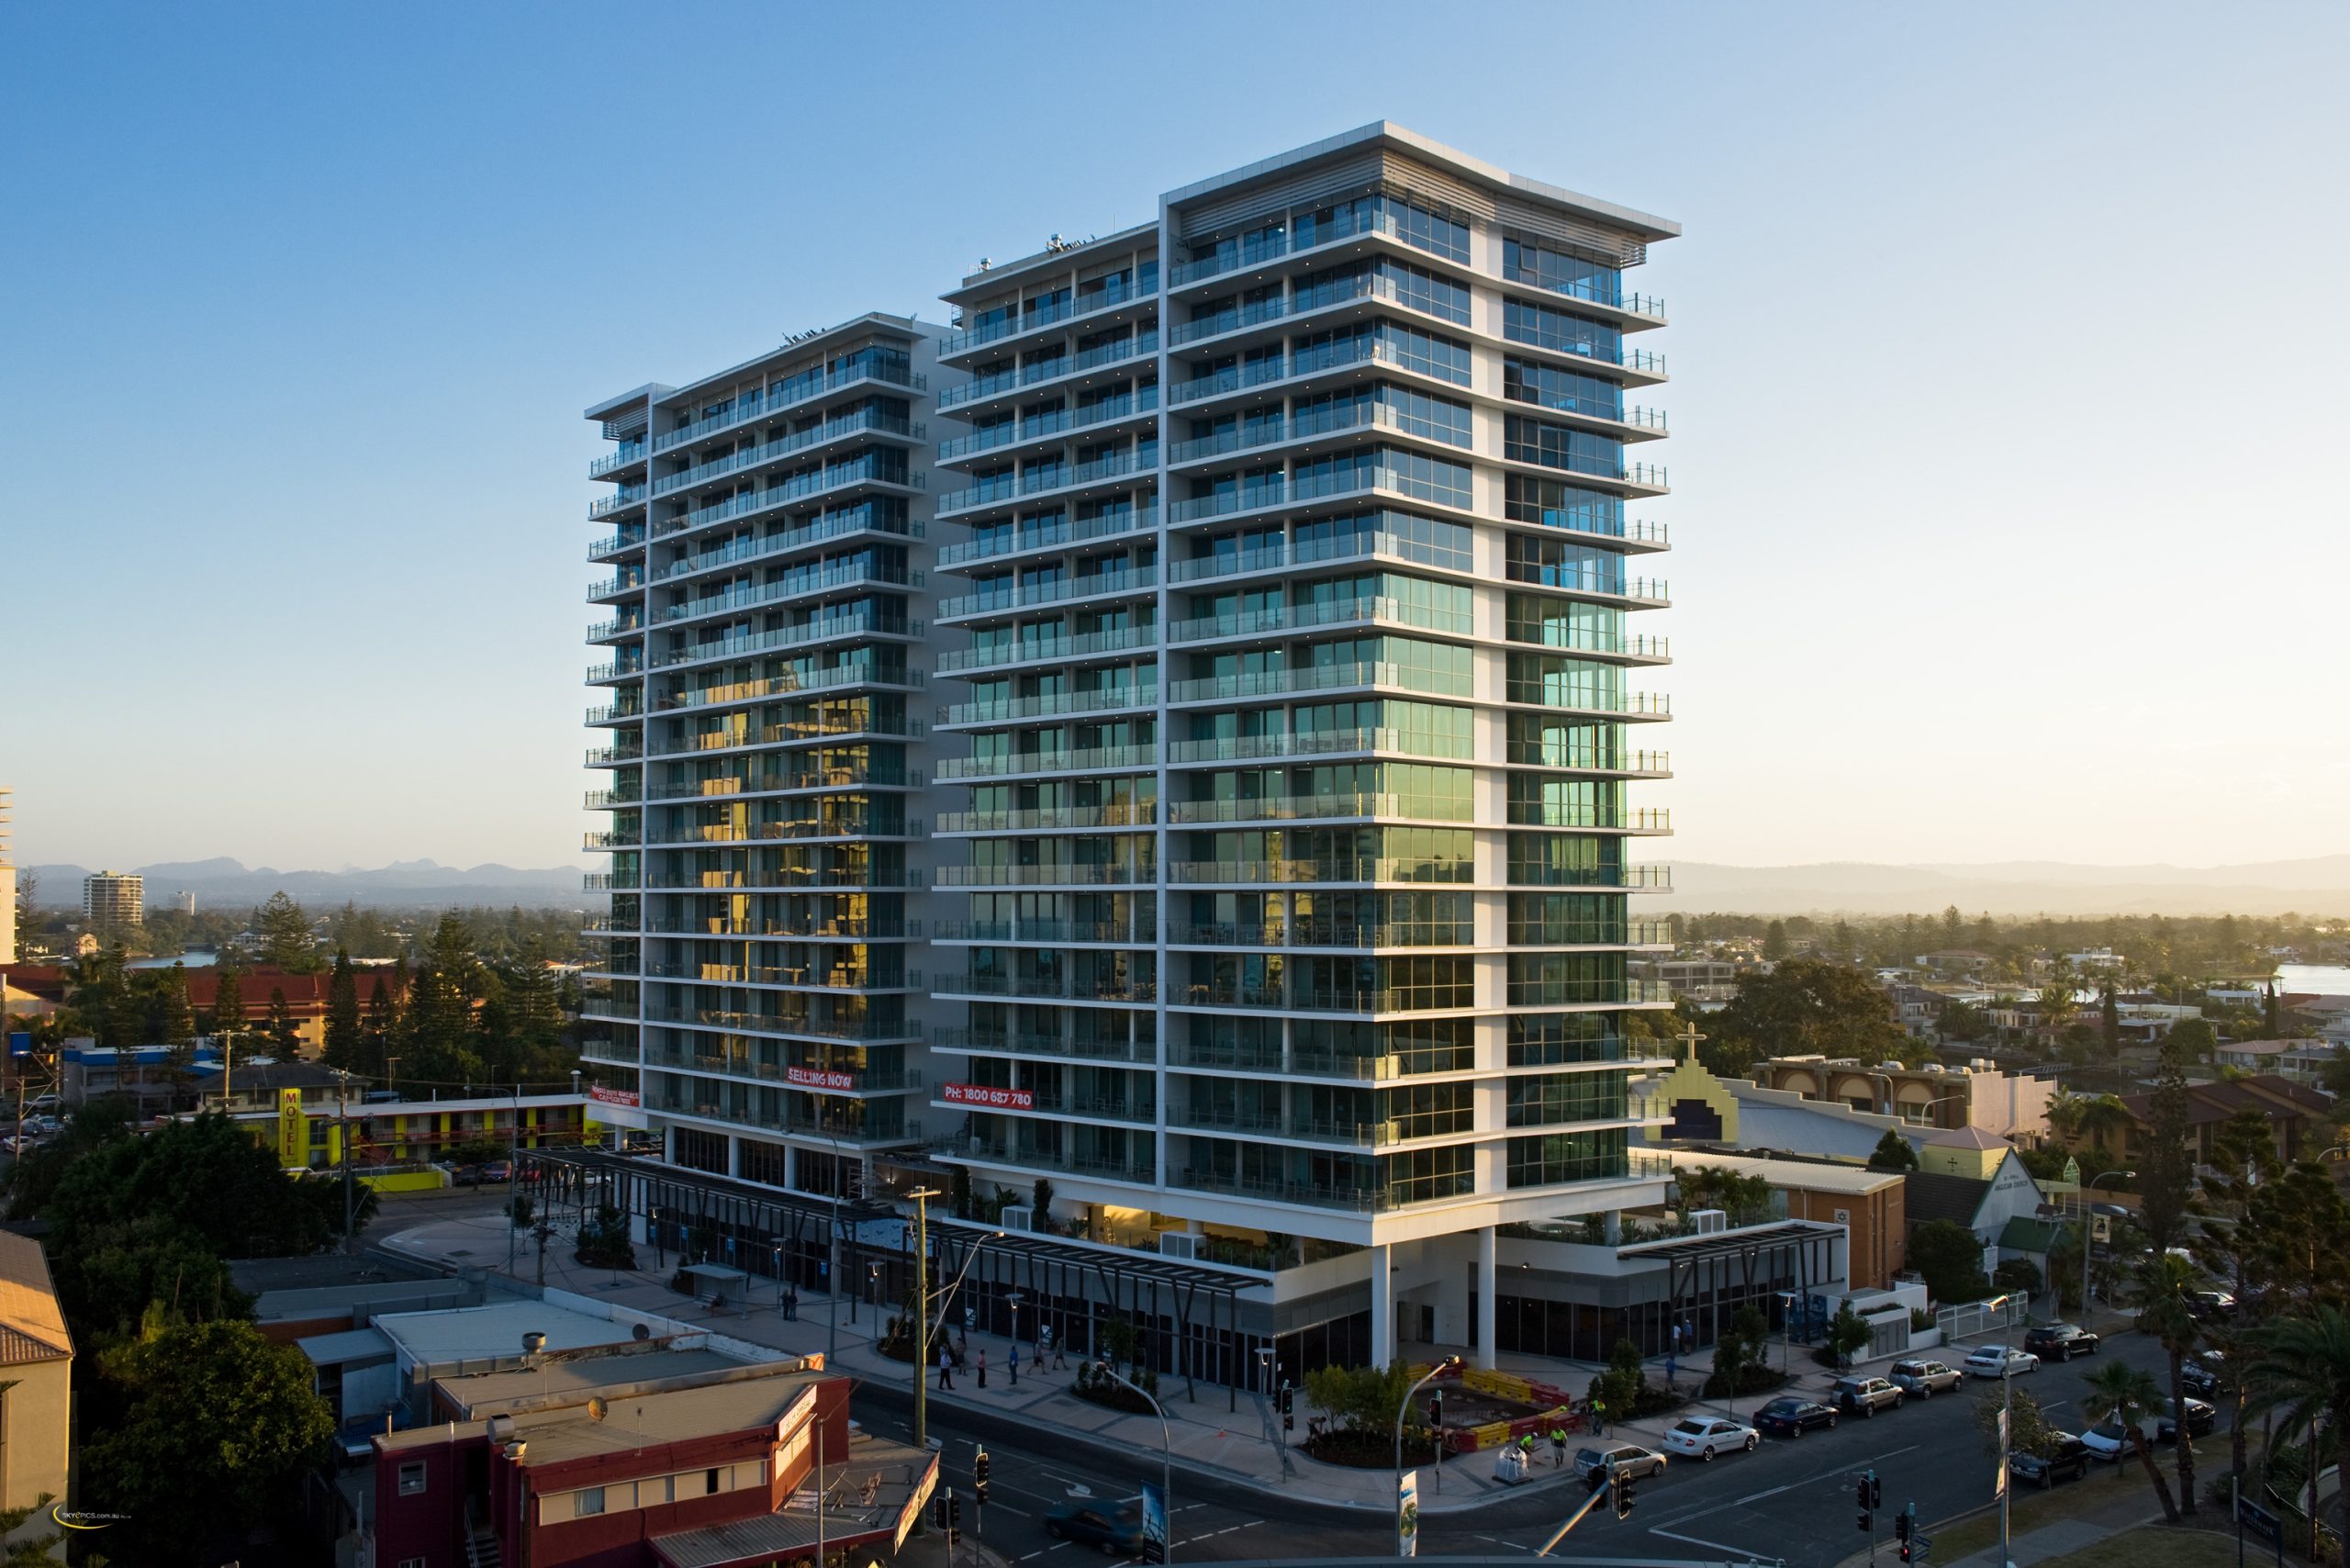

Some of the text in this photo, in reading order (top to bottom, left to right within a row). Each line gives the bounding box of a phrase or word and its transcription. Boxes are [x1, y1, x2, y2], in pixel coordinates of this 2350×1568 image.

[788, 1068, 852, 1087] SELLING NOW
[946, 1086, 961, 1098] PH:
[964, 1088, 989, 1101] 1800
[1012, 1093, 1032, 1105] 780
[285, 1092, 297, 1156] MOTEL
